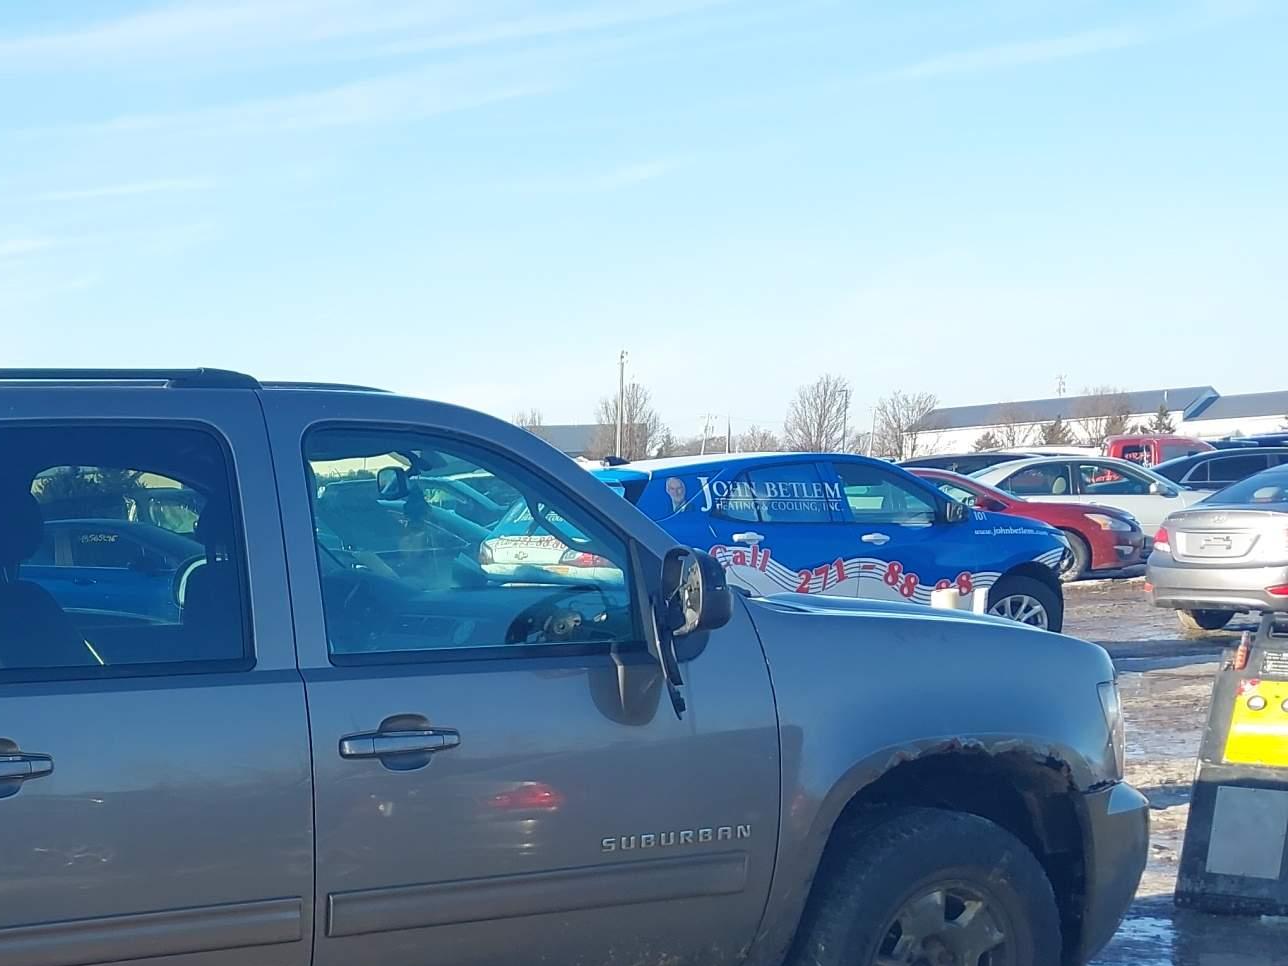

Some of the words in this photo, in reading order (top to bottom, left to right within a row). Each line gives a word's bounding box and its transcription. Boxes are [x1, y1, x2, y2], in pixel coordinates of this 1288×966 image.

[697, 477, 757, 512] JOHN
[765, 481, 842, 499] BETLEM
[716, 501, 759, 512] HEATING
[973, 511, 988, 521] 101
[974, 526, 1049, 536] www.johnbetlem.
[601, 824, 752, 853] SUBURBAN
